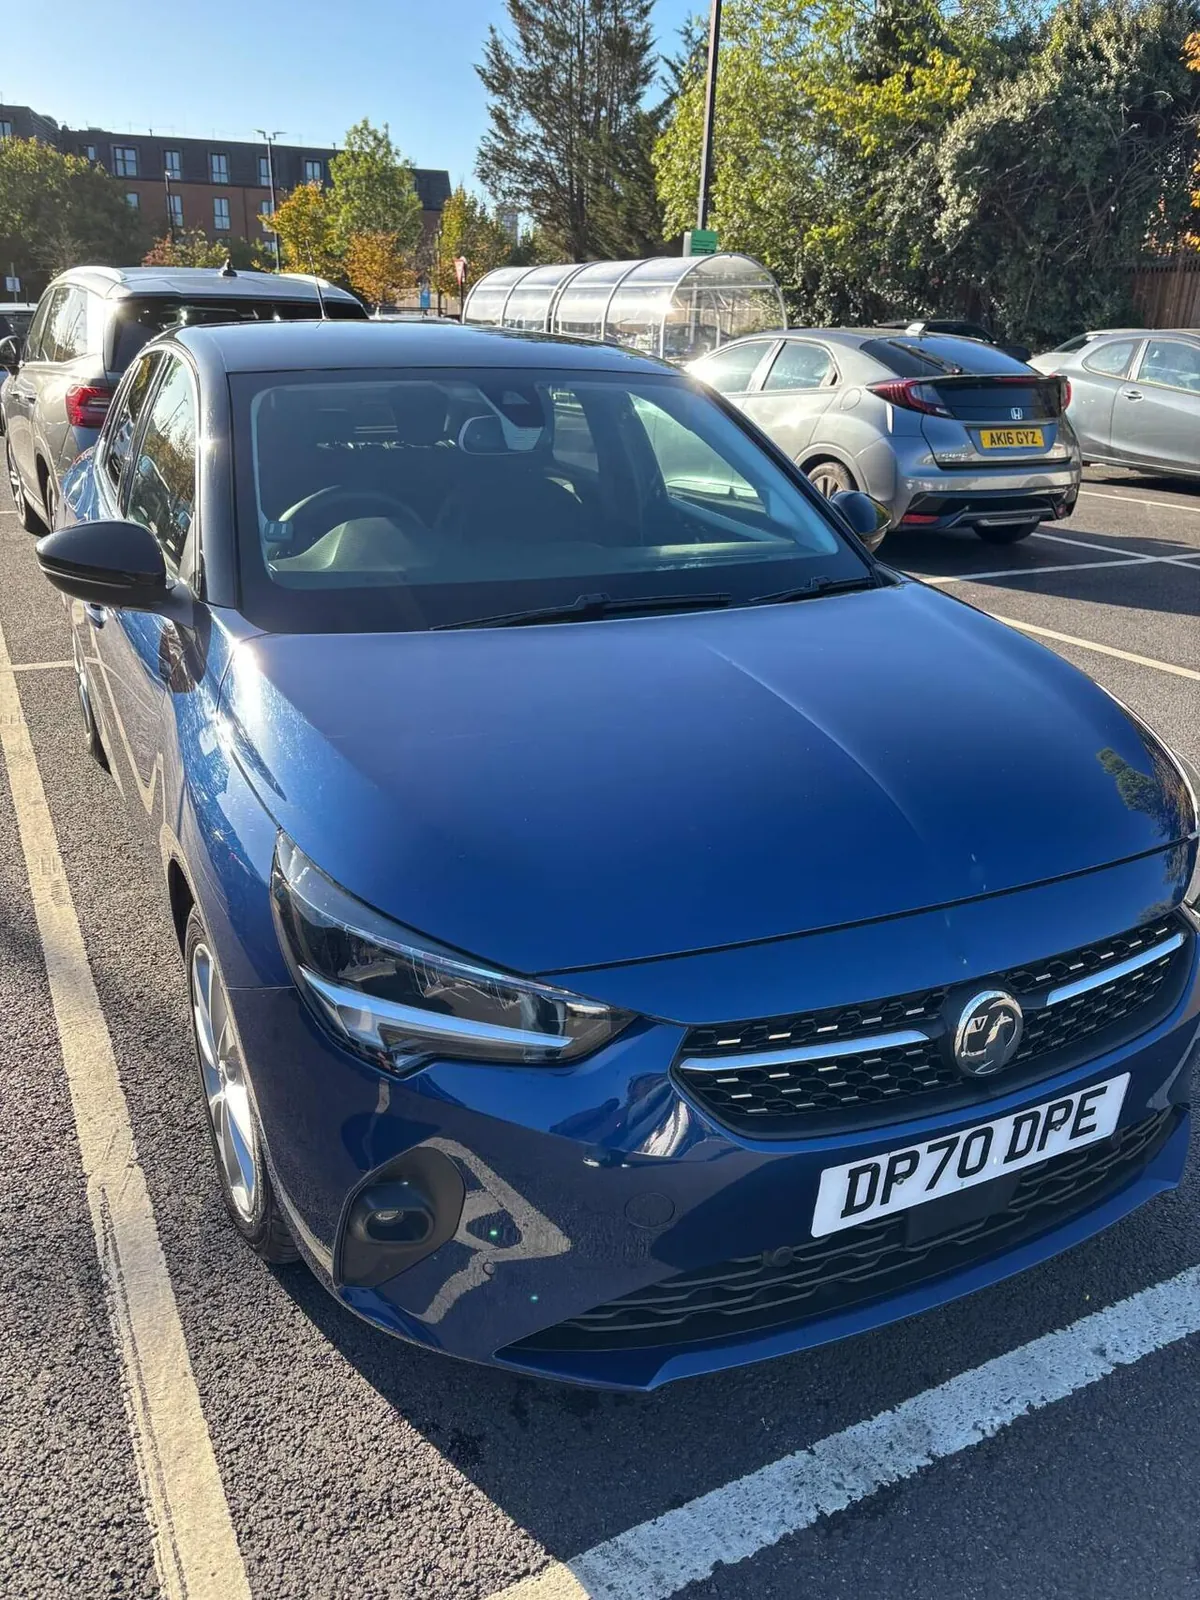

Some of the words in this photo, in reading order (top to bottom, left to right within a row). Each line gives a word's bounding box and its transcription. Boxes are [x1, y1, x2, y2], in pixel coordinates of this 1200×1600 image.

[989, 431, 1014, 446] AK16
[1015, 431, 1038, 445] GYZ
[840, 1126, 994, 1219] DP70
[1002, 1085, 1108, 1166] DPE
